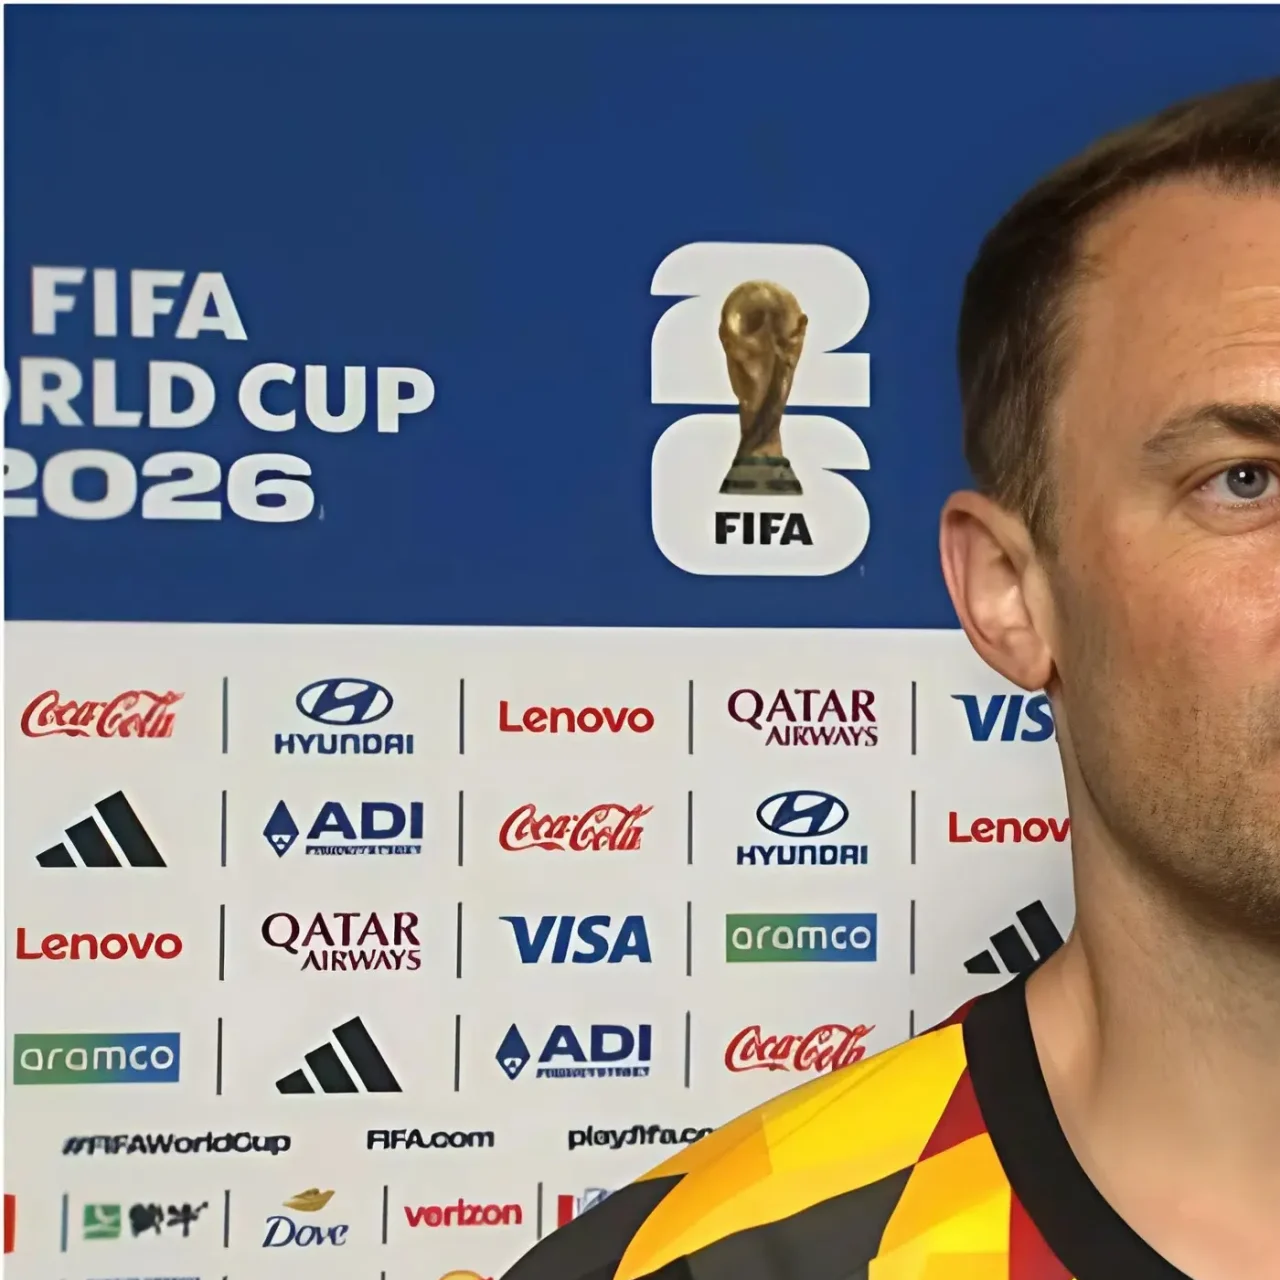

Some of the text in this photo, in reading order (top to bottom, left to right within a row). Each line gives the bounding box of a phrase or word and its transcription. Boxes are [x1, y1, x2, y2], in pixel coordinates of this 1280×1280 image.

[32, 266, 248, 340] FIFA
[4, 357, 435, 433] RLD CUP
[715, 512, 813, 545] FIFA
[500, 700, 654, 733] Lenovo
[728, 689, 878, 730] QATAR
[275, 733, 414, 755] HYUNDAI
[765, 726, 878, 746] AIRWAYS
[306, 801, 423, 840] ADI
[949, 811, 1072, 843] Lenov
[737, 845, 868, 865] HYUNDAI
[16, 928, 182, 960] Lenovo
[261, 912, 420, 954] QATAR
[499, 915, 652, 964] VISA
[732, 926, 871, 950] aramco
[301, 949, 421, 971] AIRWAYS
[20, 1046, 174, 1071] aramco
[538, 1024, 652, 1062] ADI
[404, 1198, 522, 1227] verizon
[262, 1216, 349, 1248] Dove
